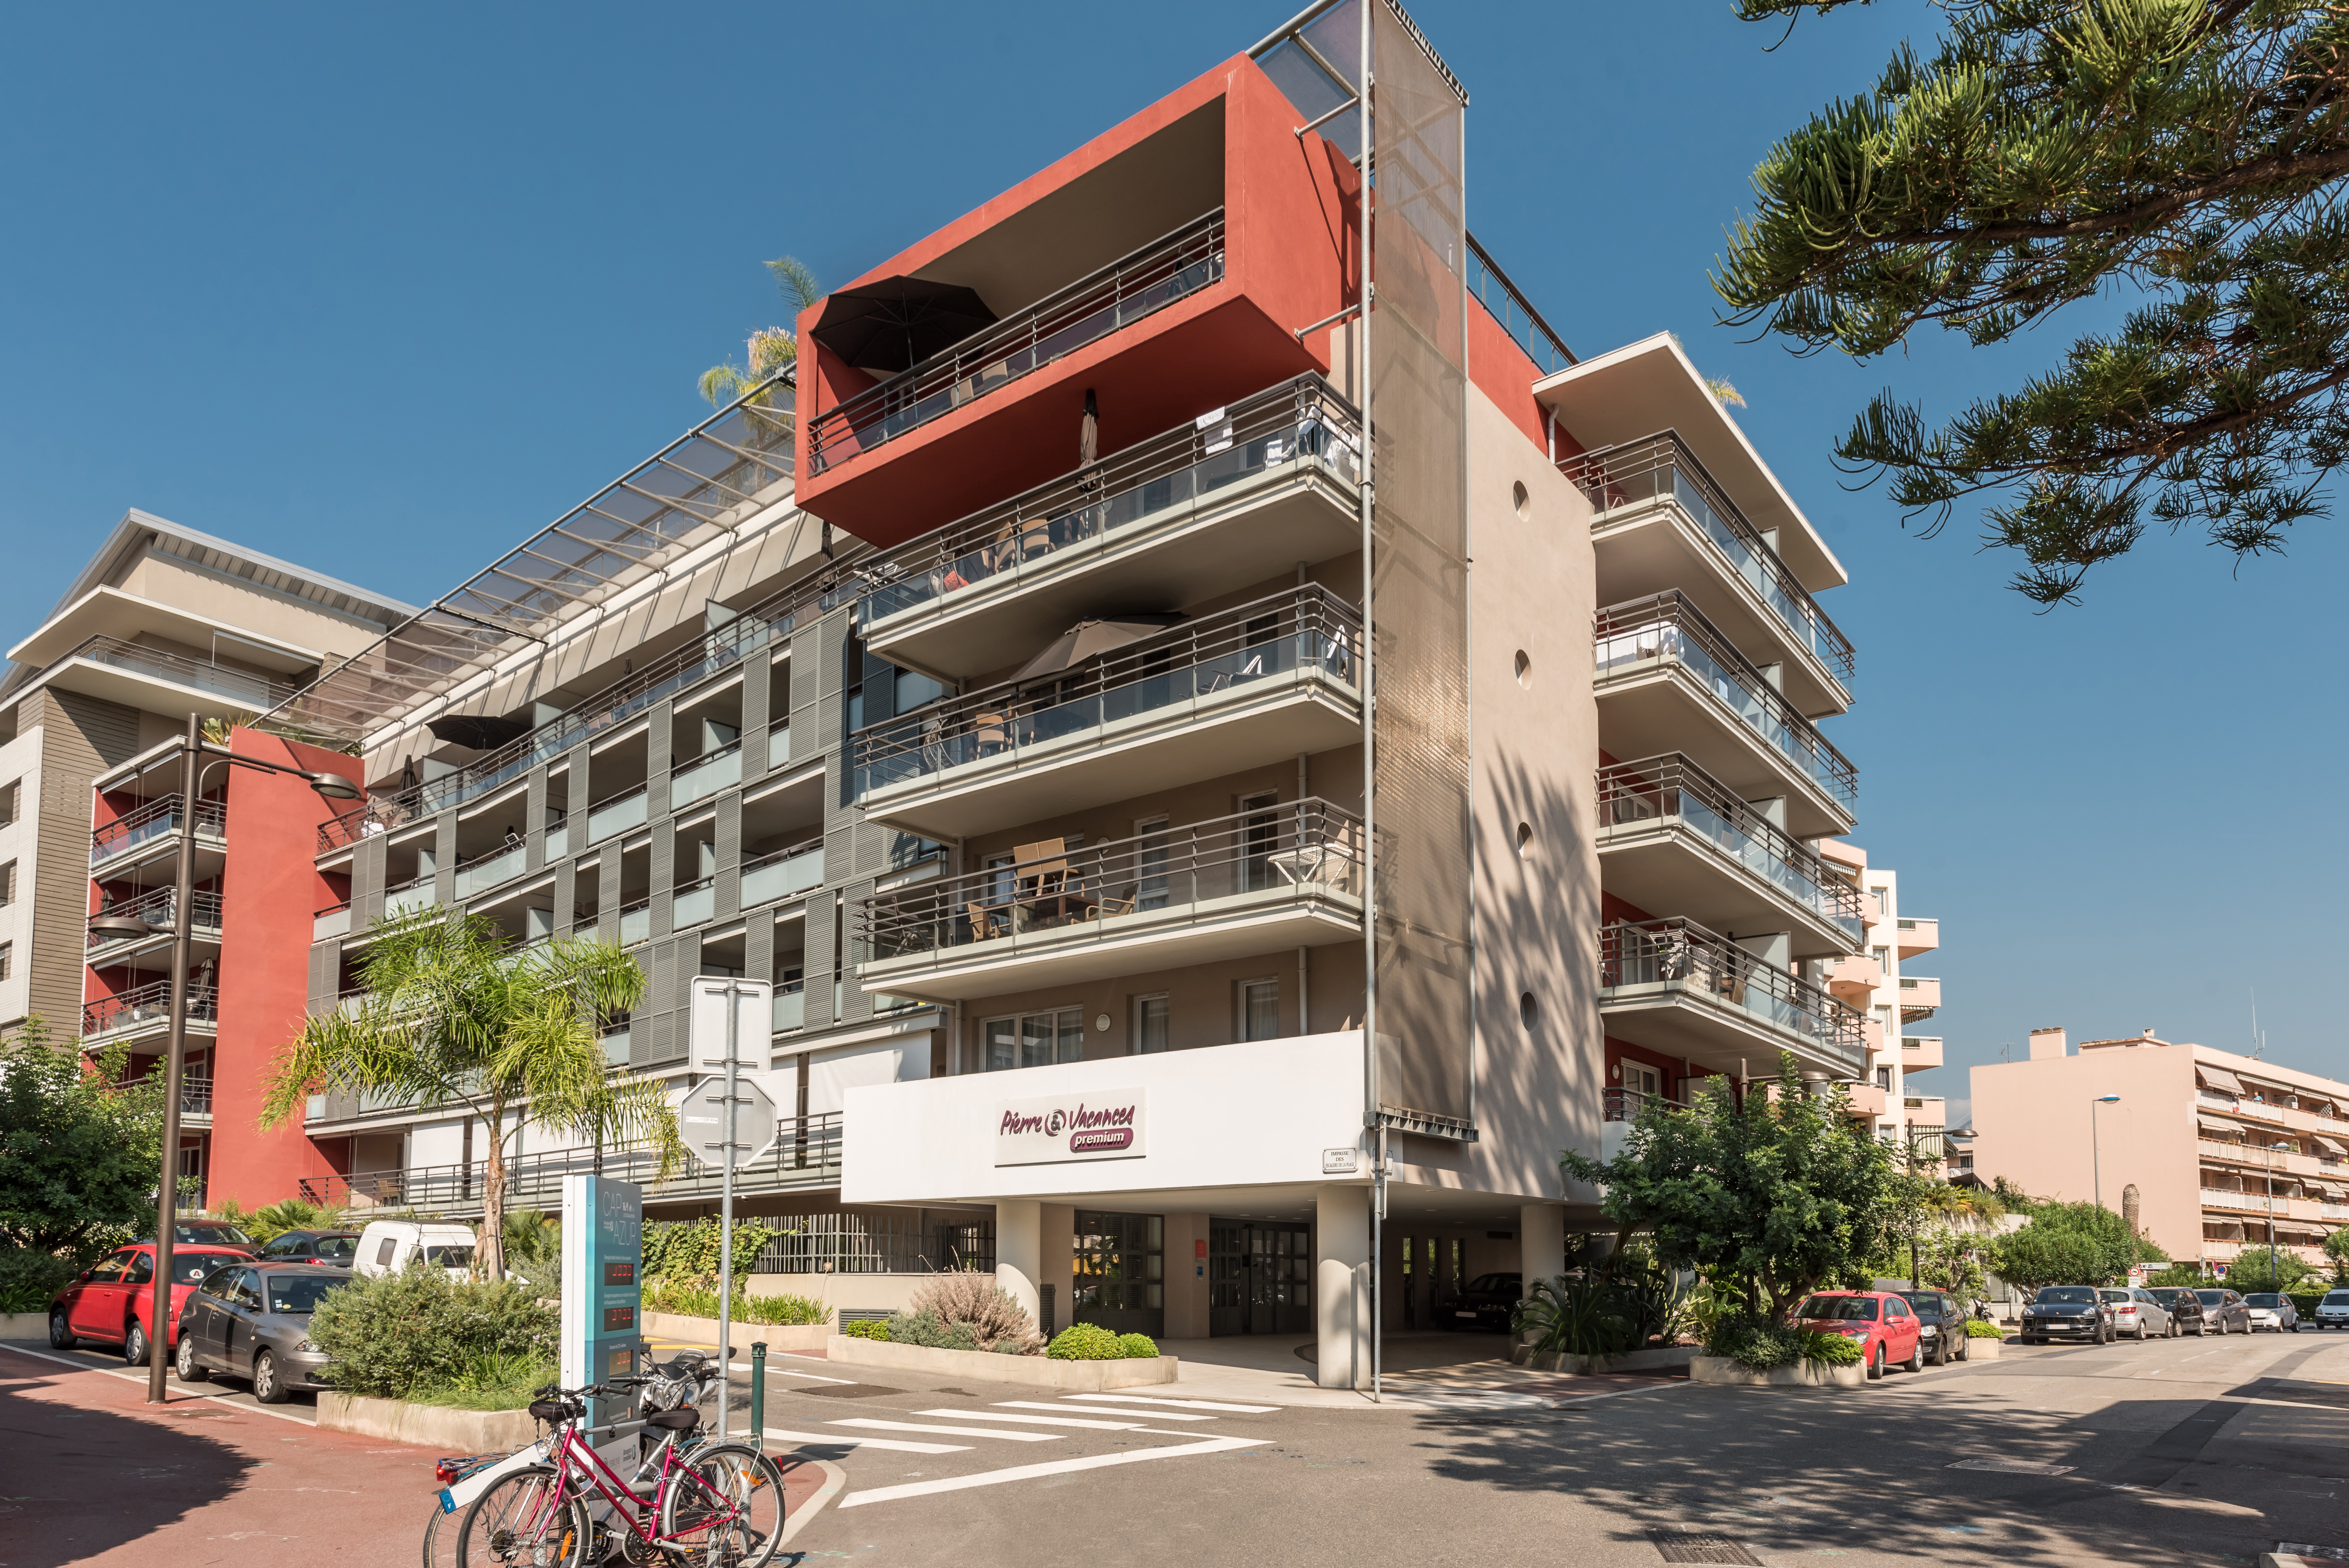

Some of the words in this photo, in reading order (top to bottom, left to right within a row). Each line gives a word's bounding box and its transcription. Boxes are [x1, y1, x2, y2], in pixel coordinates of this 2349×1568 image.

[1069, 1103, 1135, 1130] Vacances
[1075, 1131, 1125, 1148] premium
[603, 1191, 622, 1217] CAP
[613, 1220, 636, 1246] AZUR
